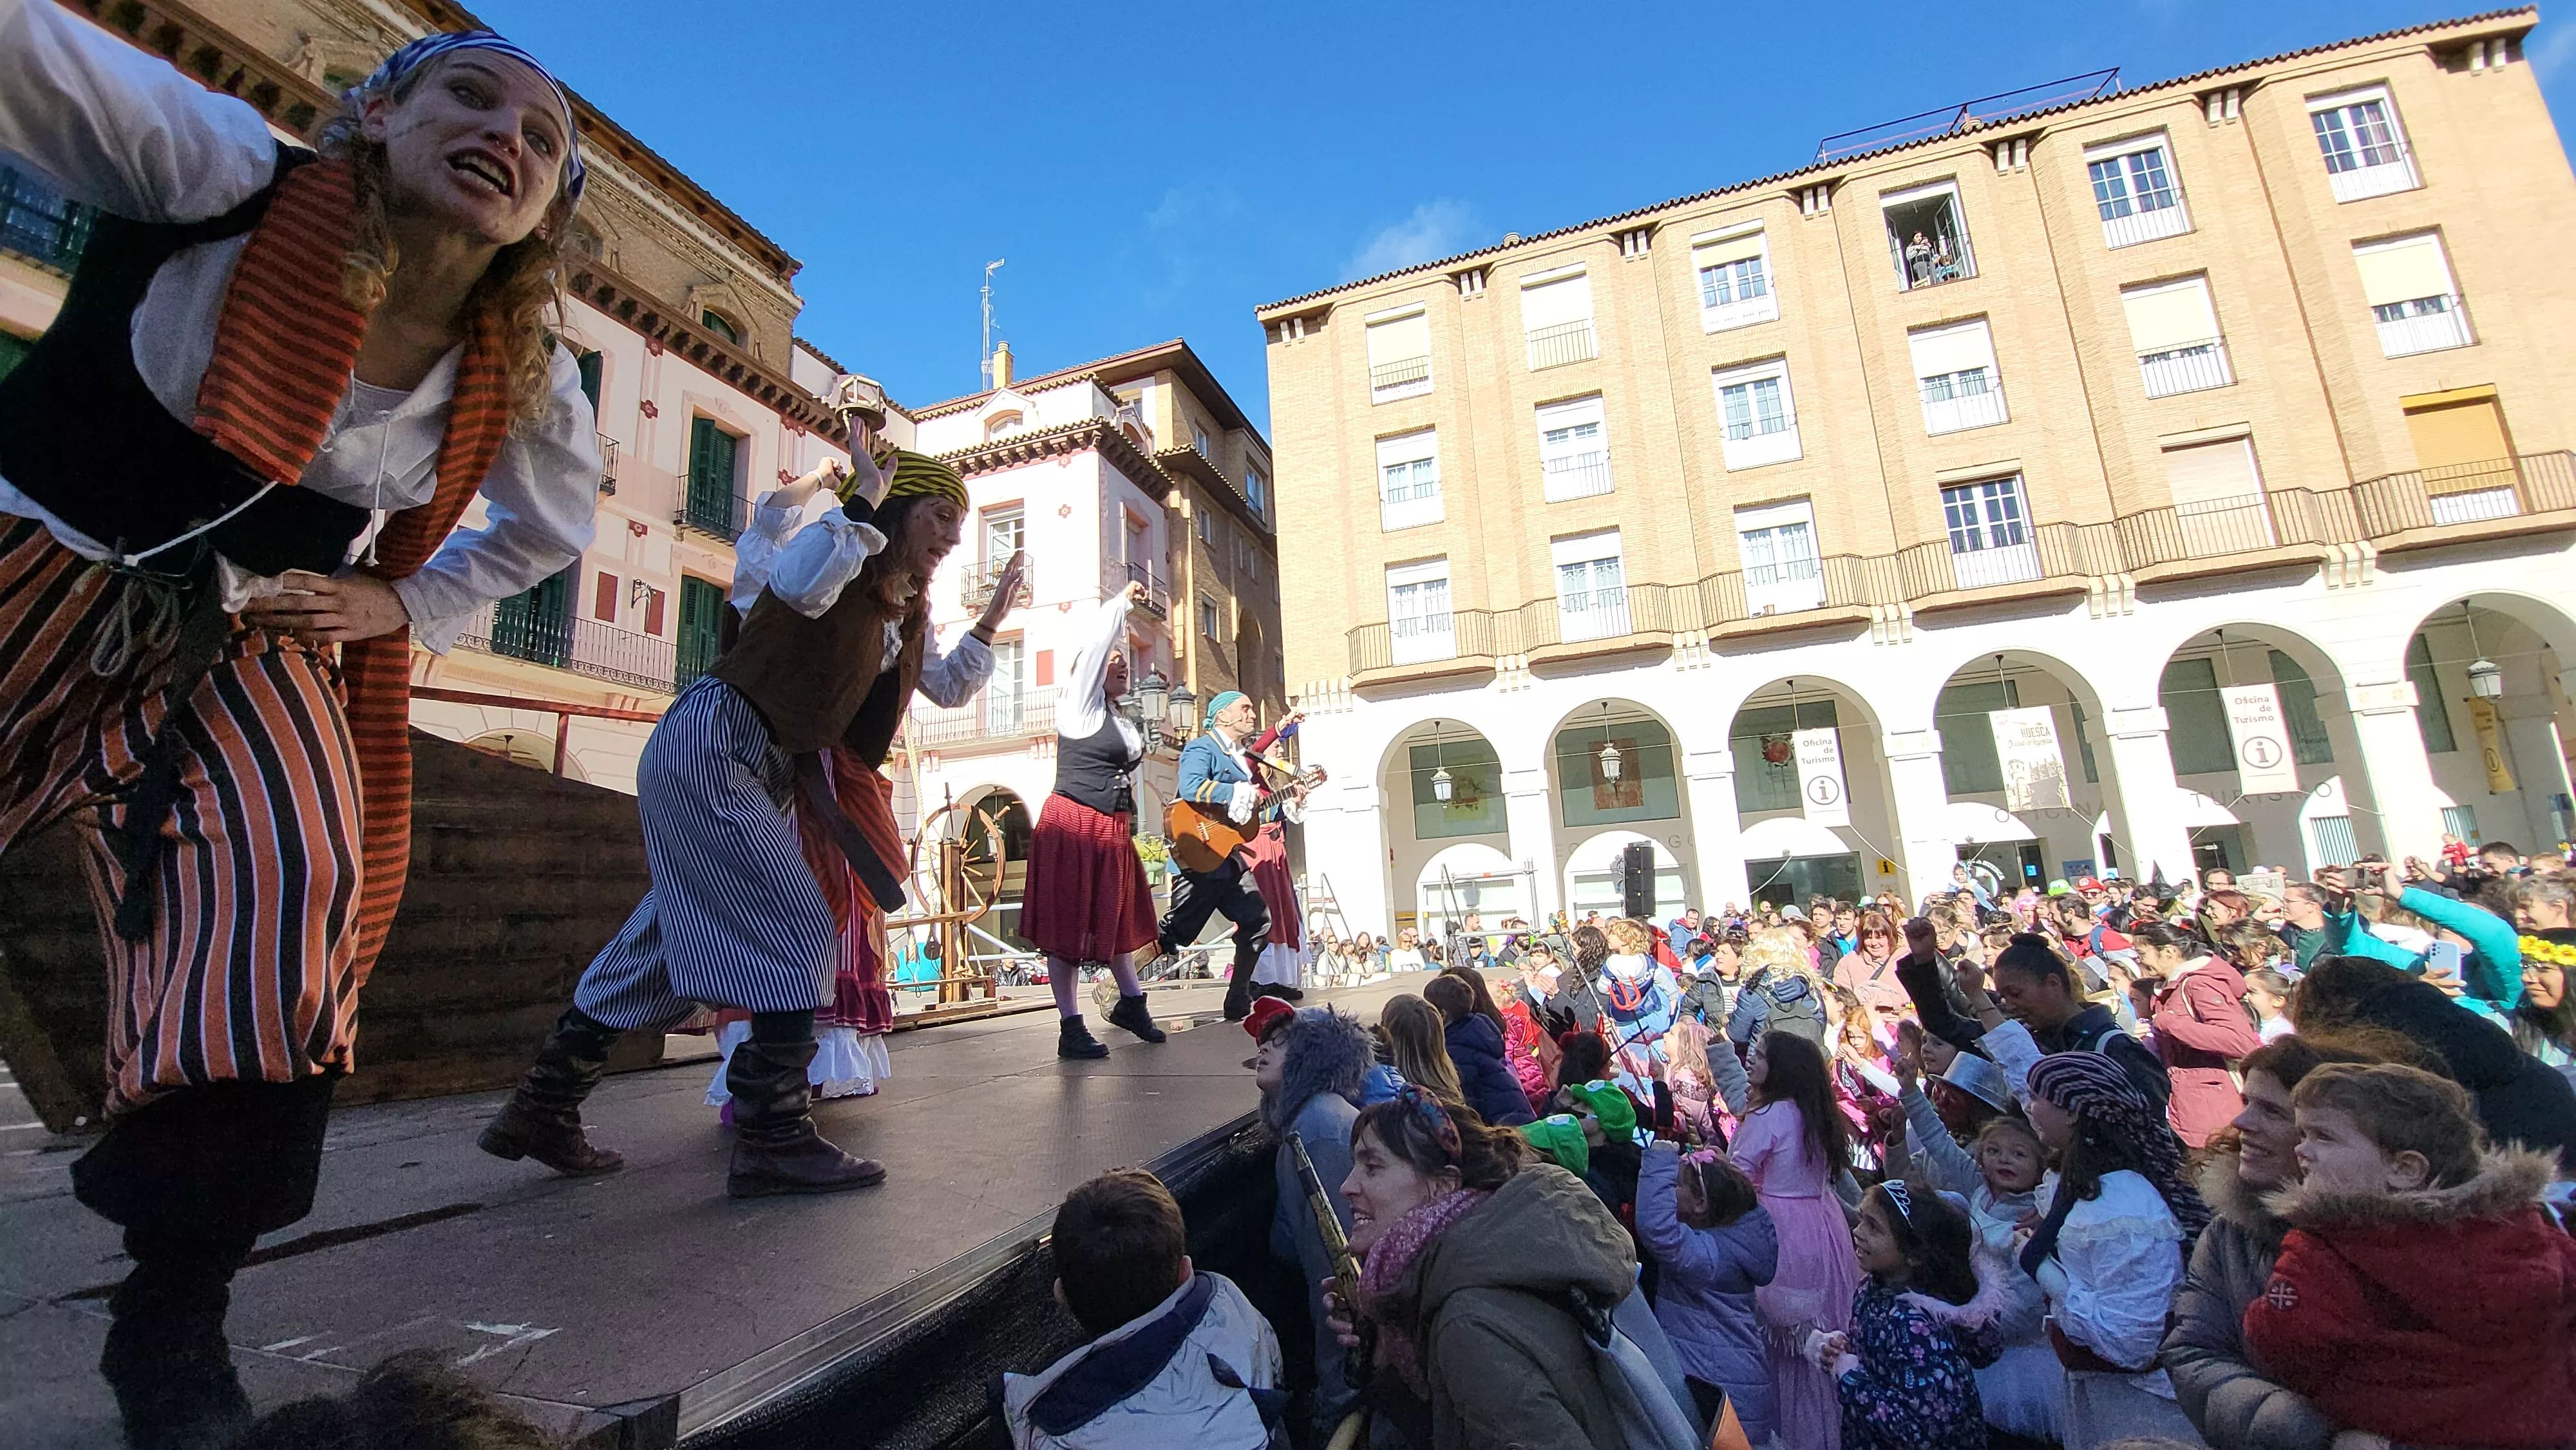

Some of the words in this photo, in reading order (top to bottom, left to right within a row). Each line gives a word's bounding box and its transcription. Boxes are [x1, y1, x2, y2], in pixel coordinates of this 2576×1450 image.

[2235, 696, 2269, 705] Oficina
[2233, 715, 2275, 724] Turismo
[2021, 726, 2051, 738] HUESCA
[1803, 739, 1832, 747] Oficina
